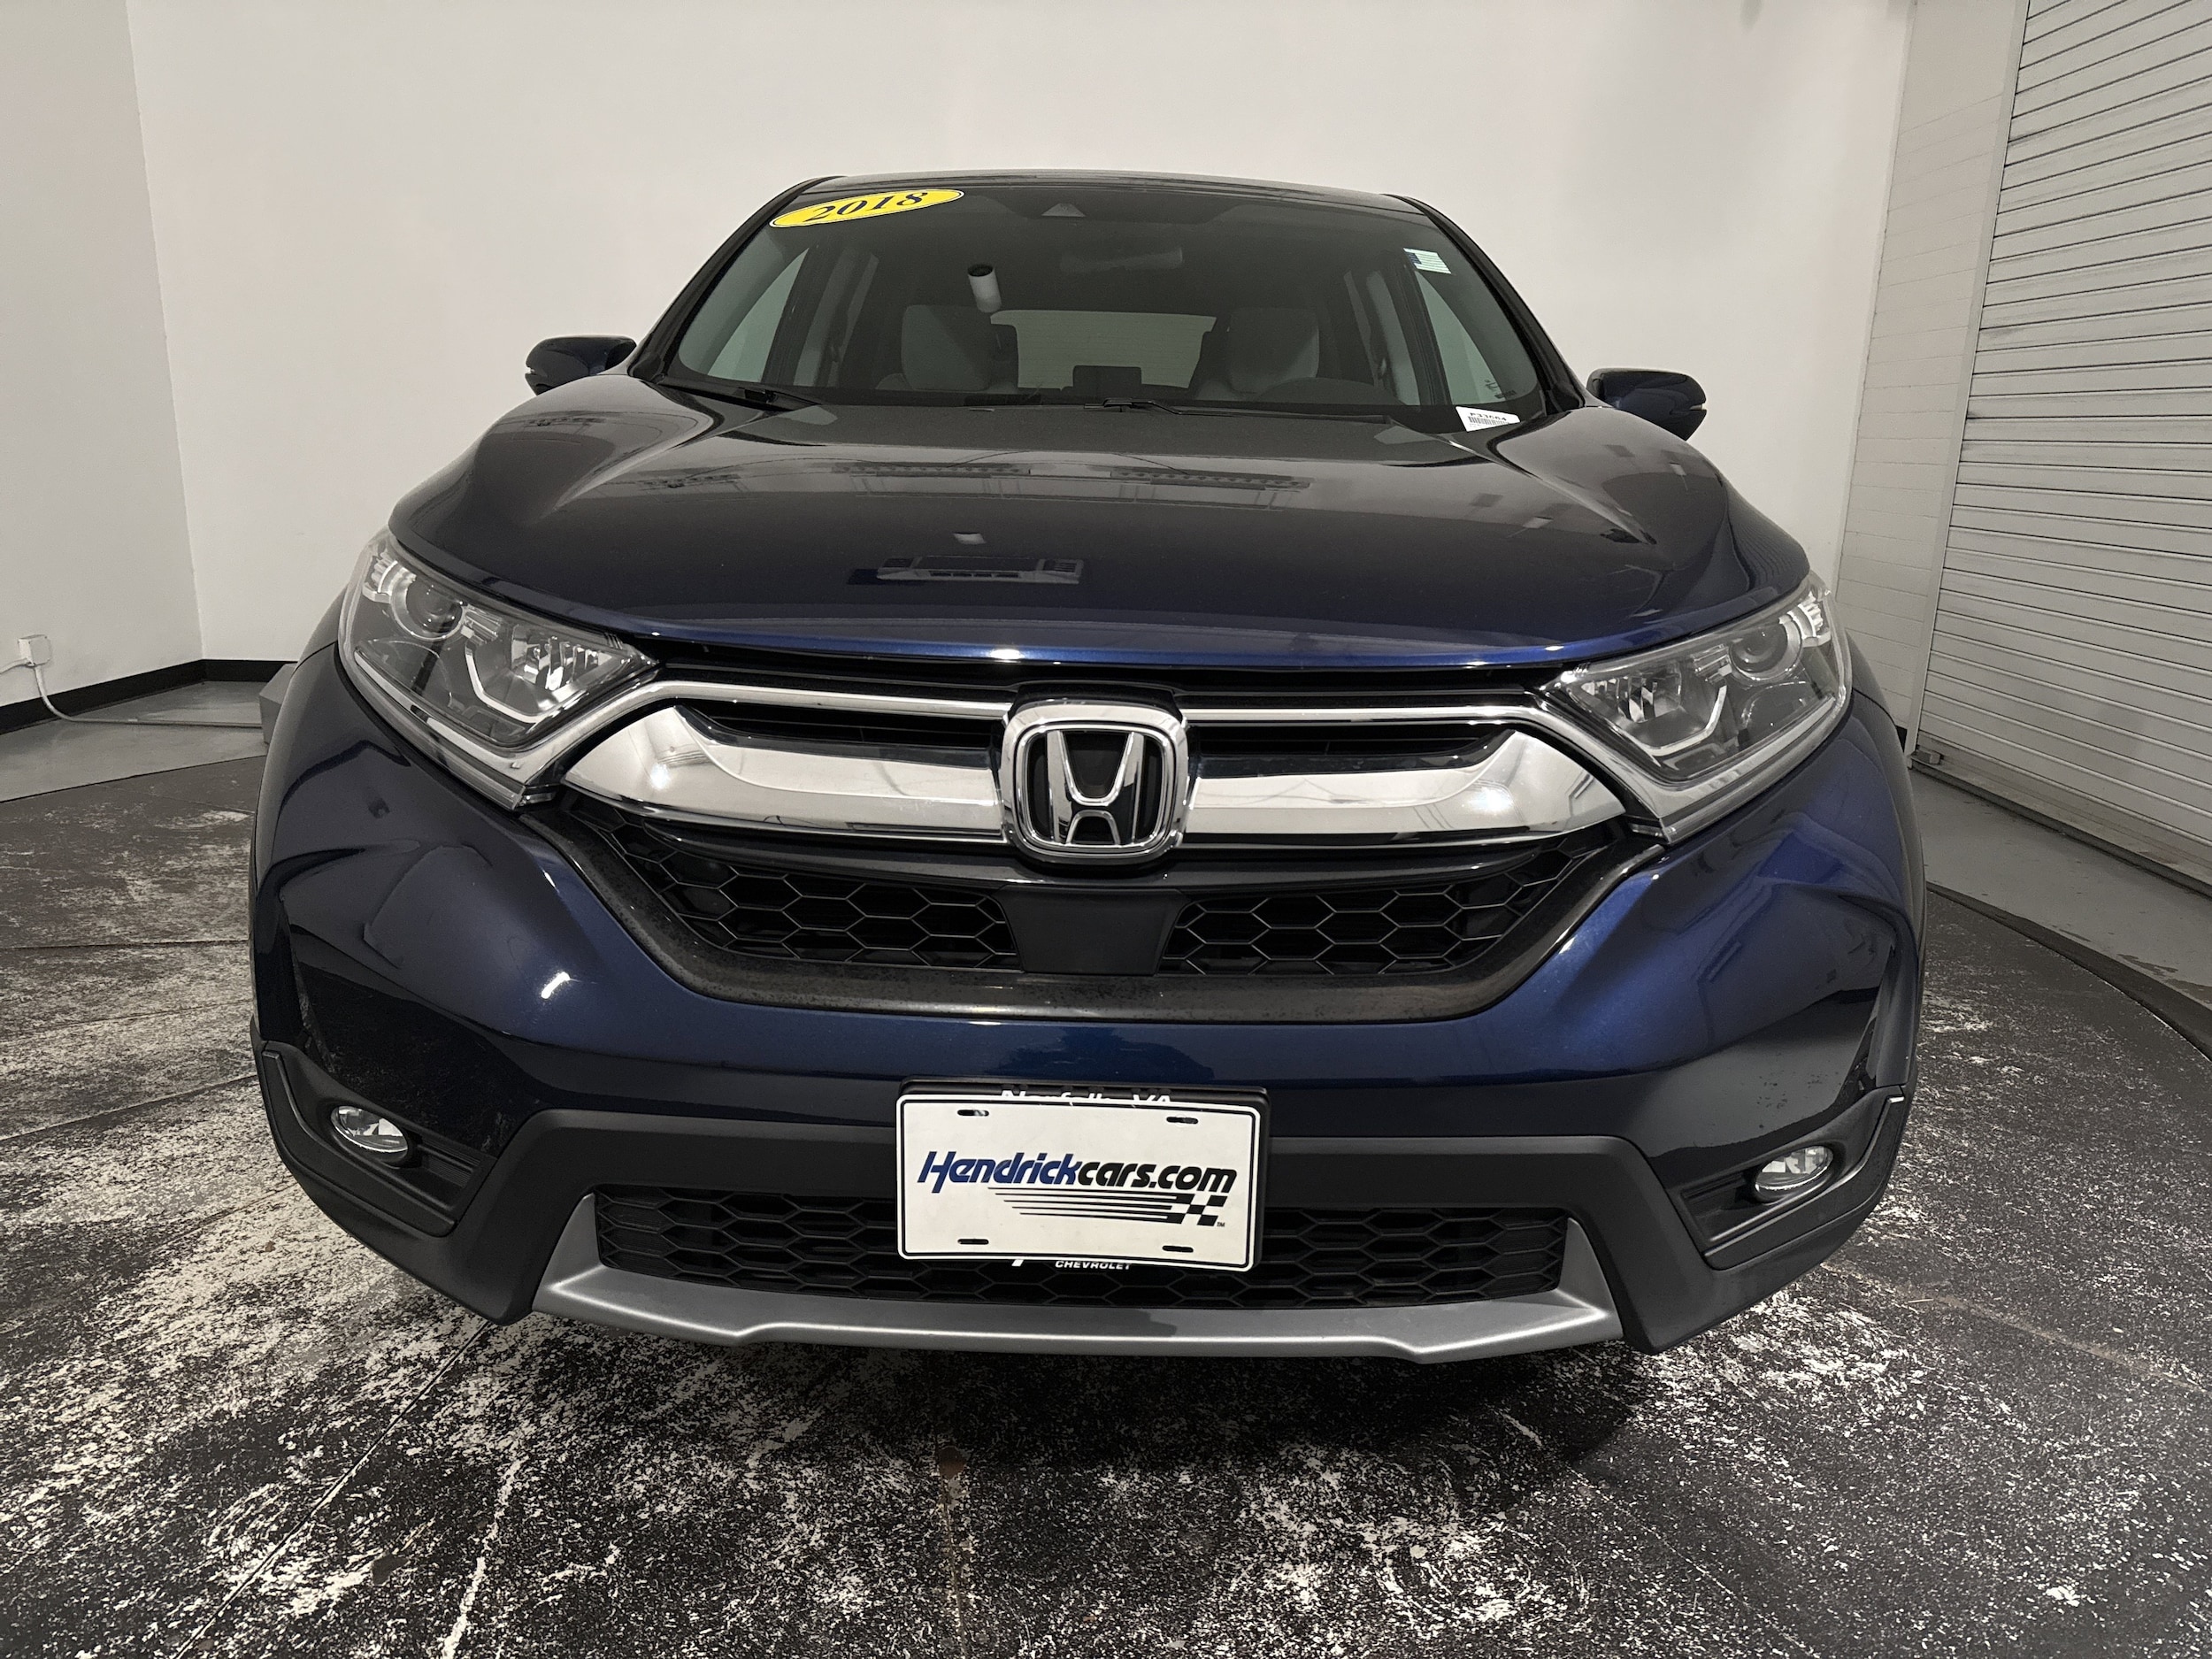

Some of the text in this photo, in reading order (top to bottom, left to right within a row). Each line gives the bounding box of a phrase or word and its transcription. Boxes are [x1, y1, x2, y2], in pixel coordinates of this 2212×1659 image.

[803, 192, 927, 222] 2018
[917, 1150, 1237, 1194] Hendrickcars.com
[1055, 1260, 1131, 1271] CHEVROLET
